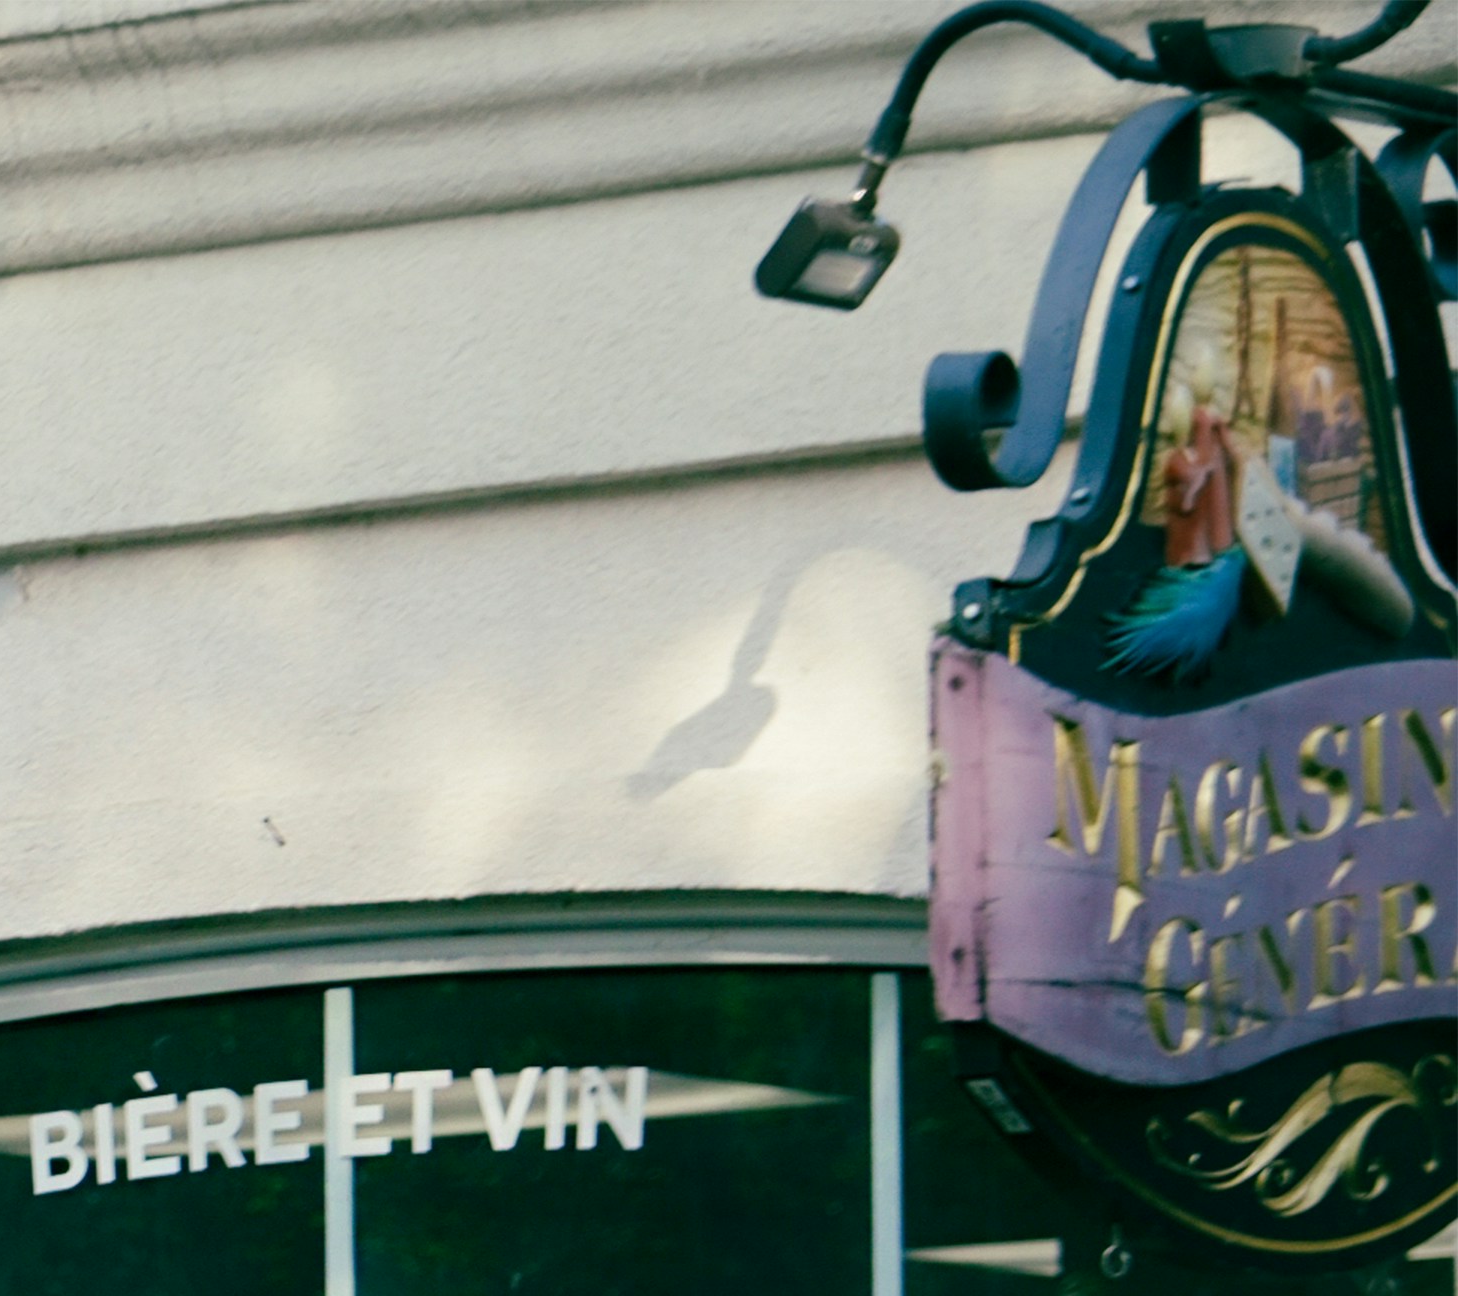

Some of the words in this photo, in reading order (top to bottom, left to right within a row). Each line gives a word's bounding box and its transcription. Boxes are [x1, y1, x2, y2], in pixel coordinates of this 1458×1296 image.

[1045, 708, 1458, 943] MAGASIN
[1143, 853, 1458, 1056] GÉNÉR
[30, 1071, 310, 1196] BIÈRE
[340, 1069, 453, 1157] ET
[470, 1066, 648, 1151] VIN
